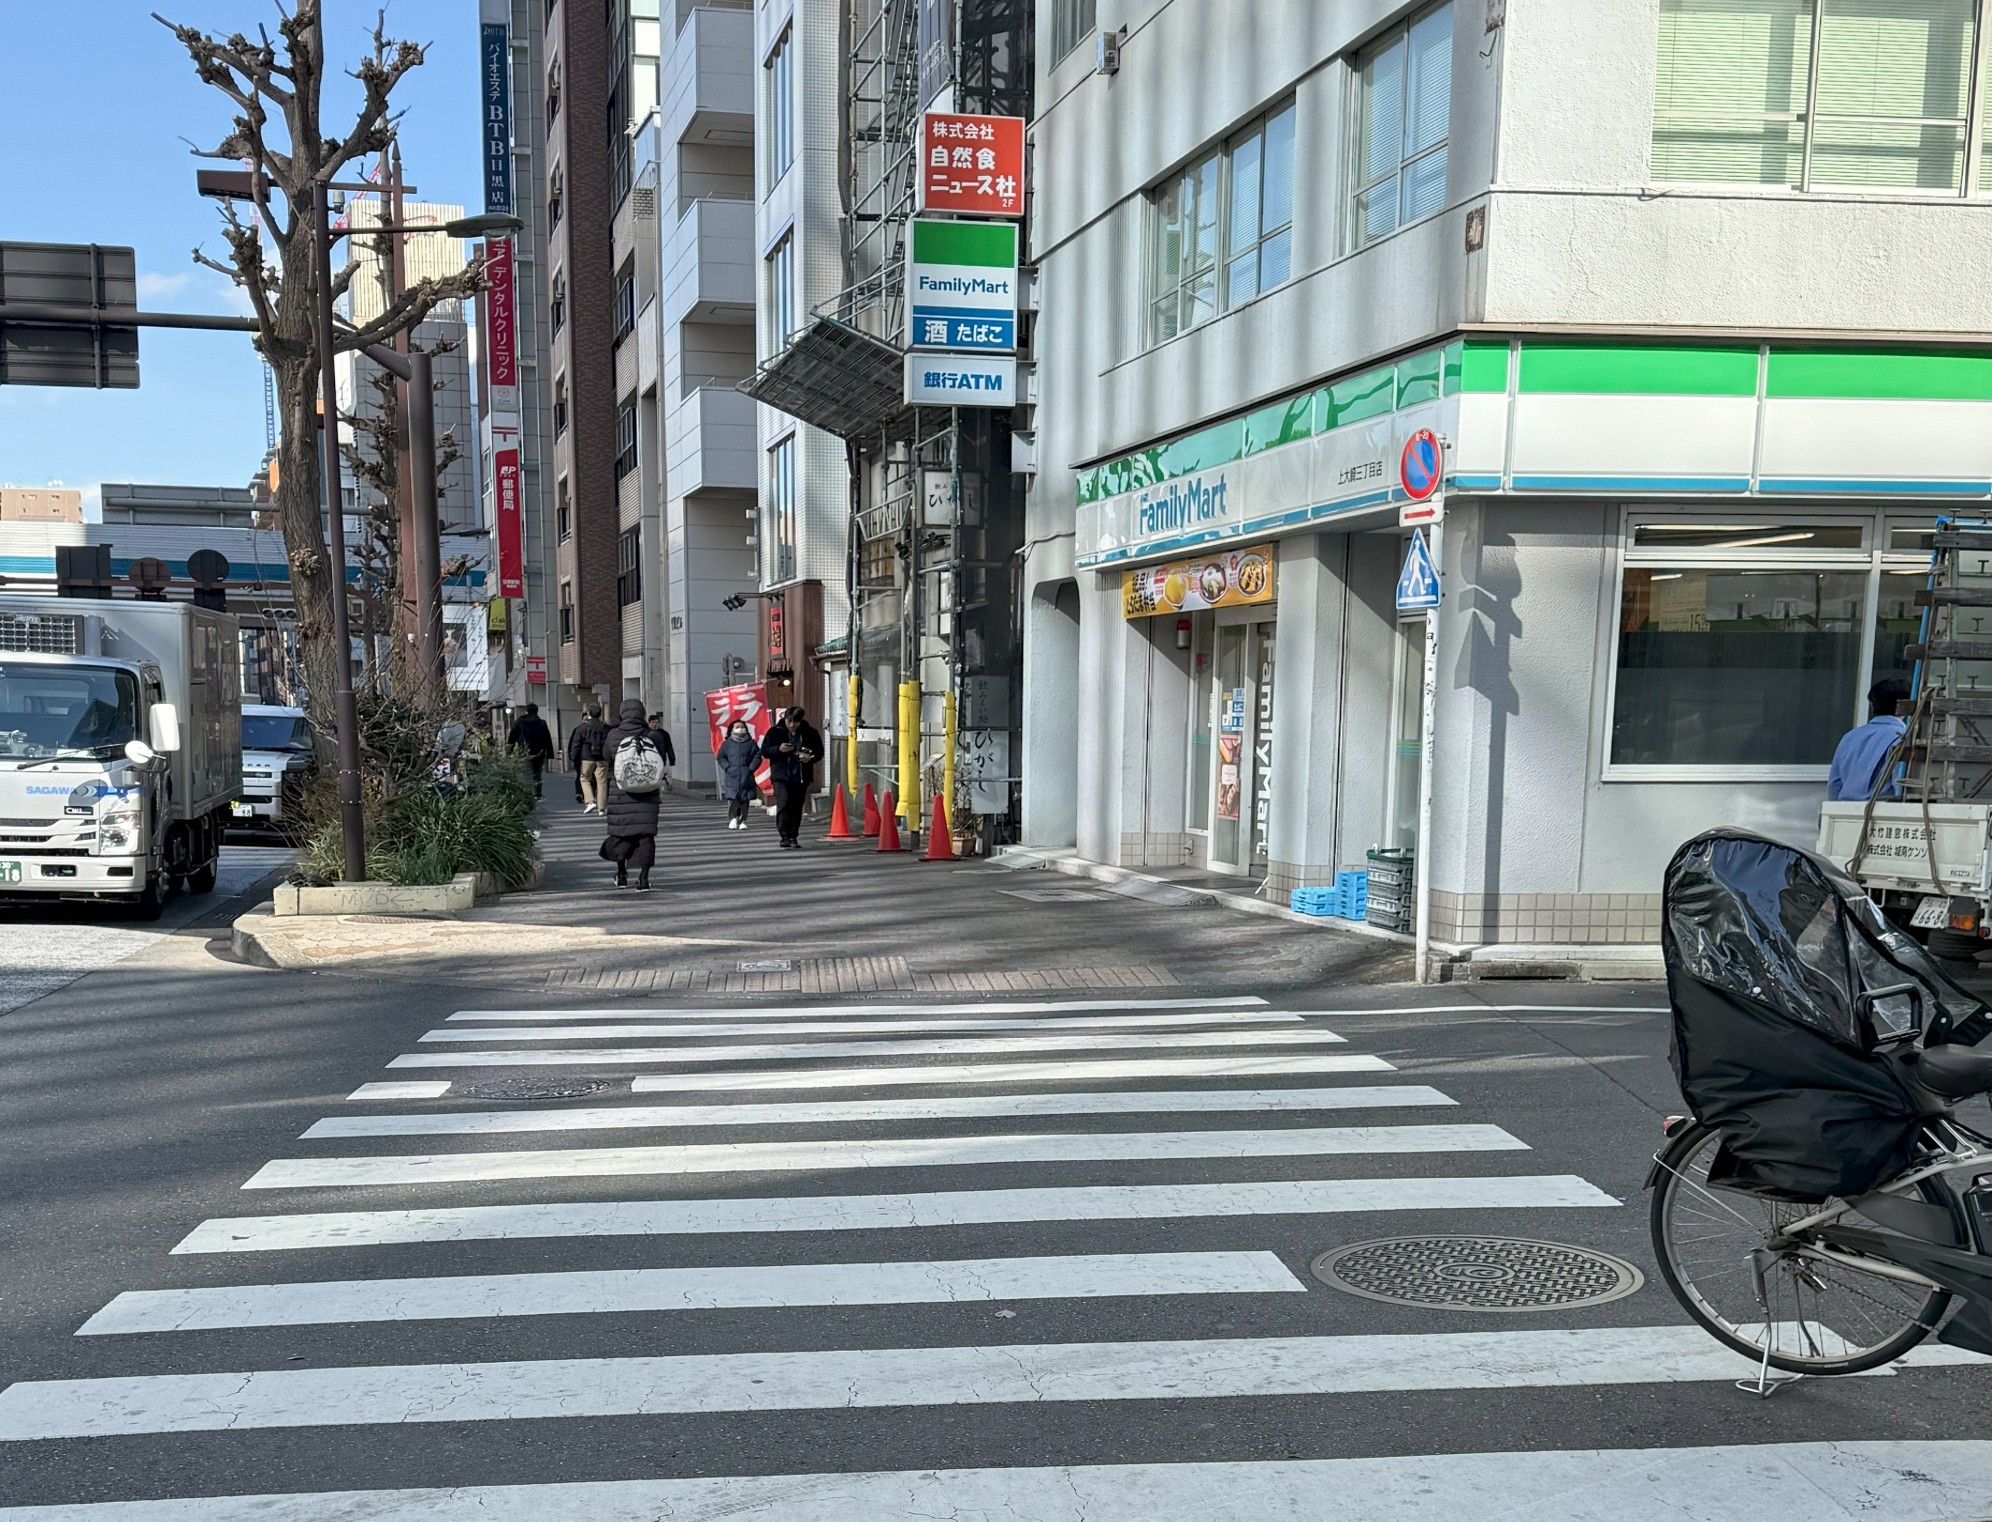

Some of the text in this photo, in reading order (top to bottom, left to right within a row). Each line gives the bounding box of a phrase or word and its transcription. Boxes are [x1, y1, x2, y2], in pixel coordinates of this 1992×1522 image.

[932, 120, 995, 140] 株式会社
[930, 146, 996, 169] 自然食
[930, 174, 1016, 198] ニュース社
[1002, 198, 1014, 207] 2F
[919, 275, 1009, 296] FamilyMart
[924, 319, 1003, 344] 酒 たばこ
[923, 371, 1002, 391] 銀行ATM
[1337, 460, 1383, 485] 上大崎三丁目店
[502, 479, 514, 511] 郵便局
[928, 493, 976, 511] ひし
[1140, 472, 1227, 536] FamilyMart
[974, 730, 994, 793] ひがし
[1867, 844, 1893, 857] 株式会社
